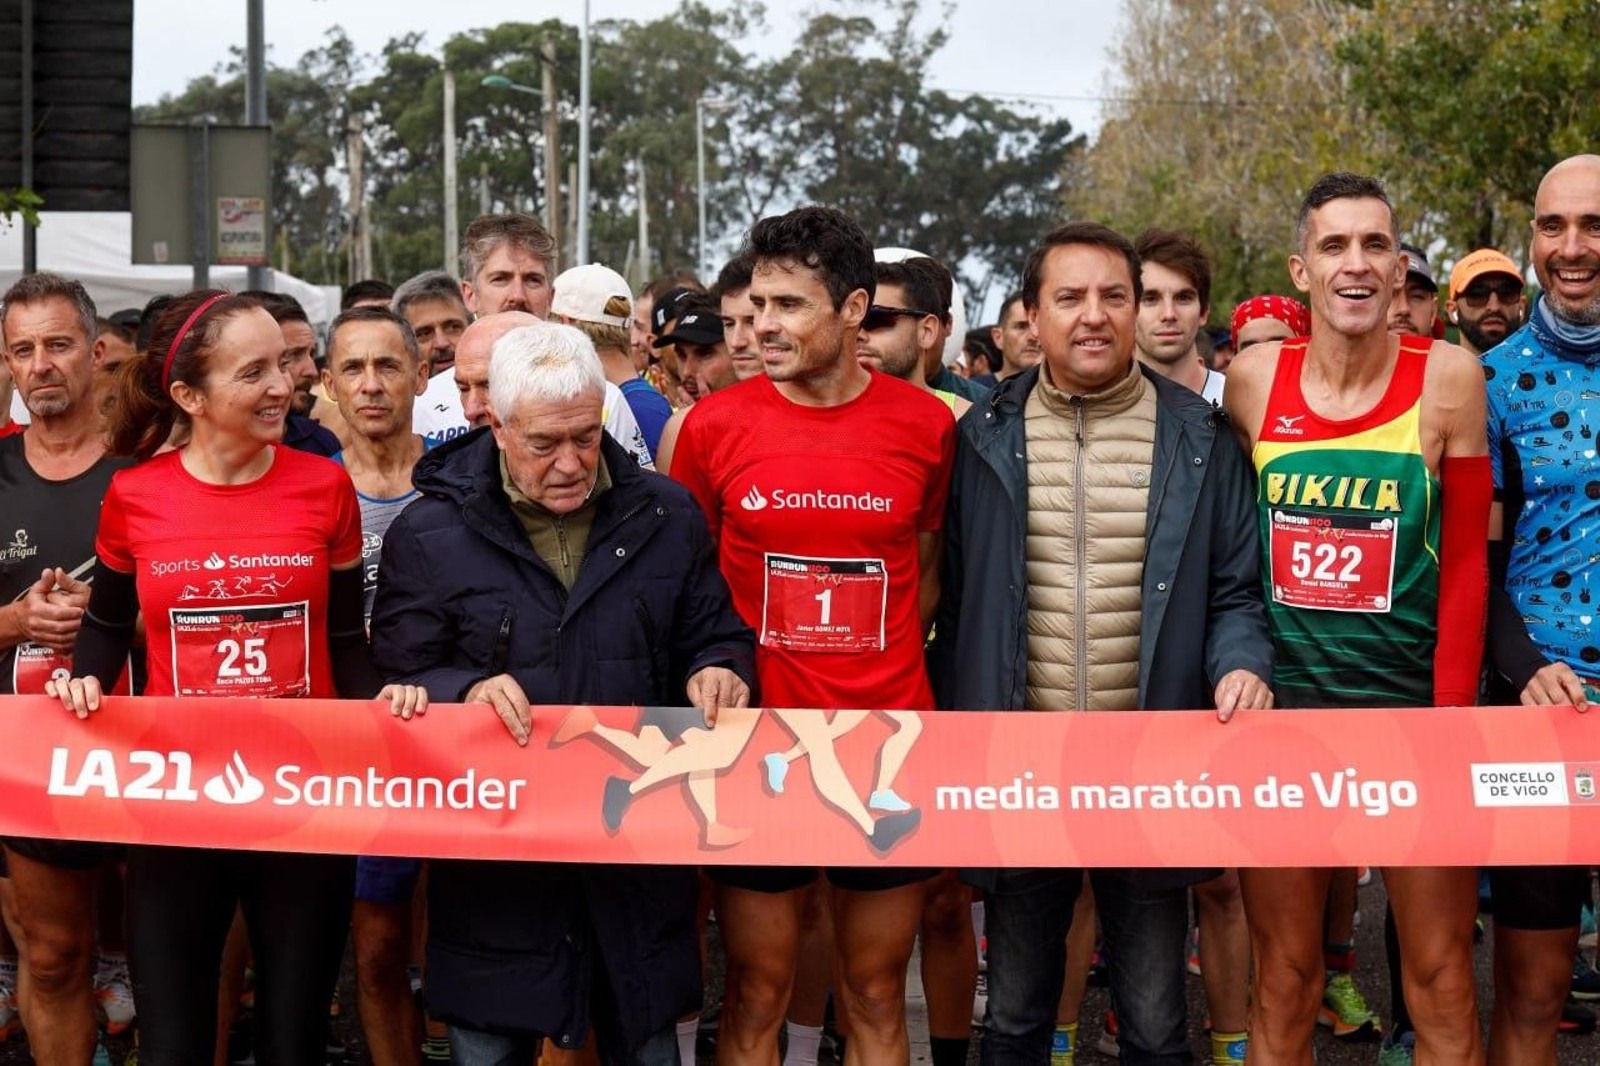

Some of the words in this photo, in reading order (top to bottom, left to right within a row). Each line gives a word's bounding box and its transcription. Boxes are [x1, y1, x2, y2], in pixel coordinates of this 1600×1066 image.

[772, 489, 893, 512] Santander
[1267, 472, 1402, 512] BIKILA
[151, 559, 200, 576] Sports
[229, 553, 314, 568] Santander
[1291, 541, 1362, 582] 522
[815, 589, 832, 624] 1
[217, 638, 267, 676] 25
[273, 766, 526, 809] Santander
[936, 771, 1060, 810] media
[1071, 773, 1241, 809] maratón
[1254, 776, 1304, 808] de
[1312, 768, 1417, 816] Vigo
[1479, 772, 1555, 783] CONCELLO
[1490, 786, 1509, 796] DE
[1513, 785, 1548, 796] VIGO
